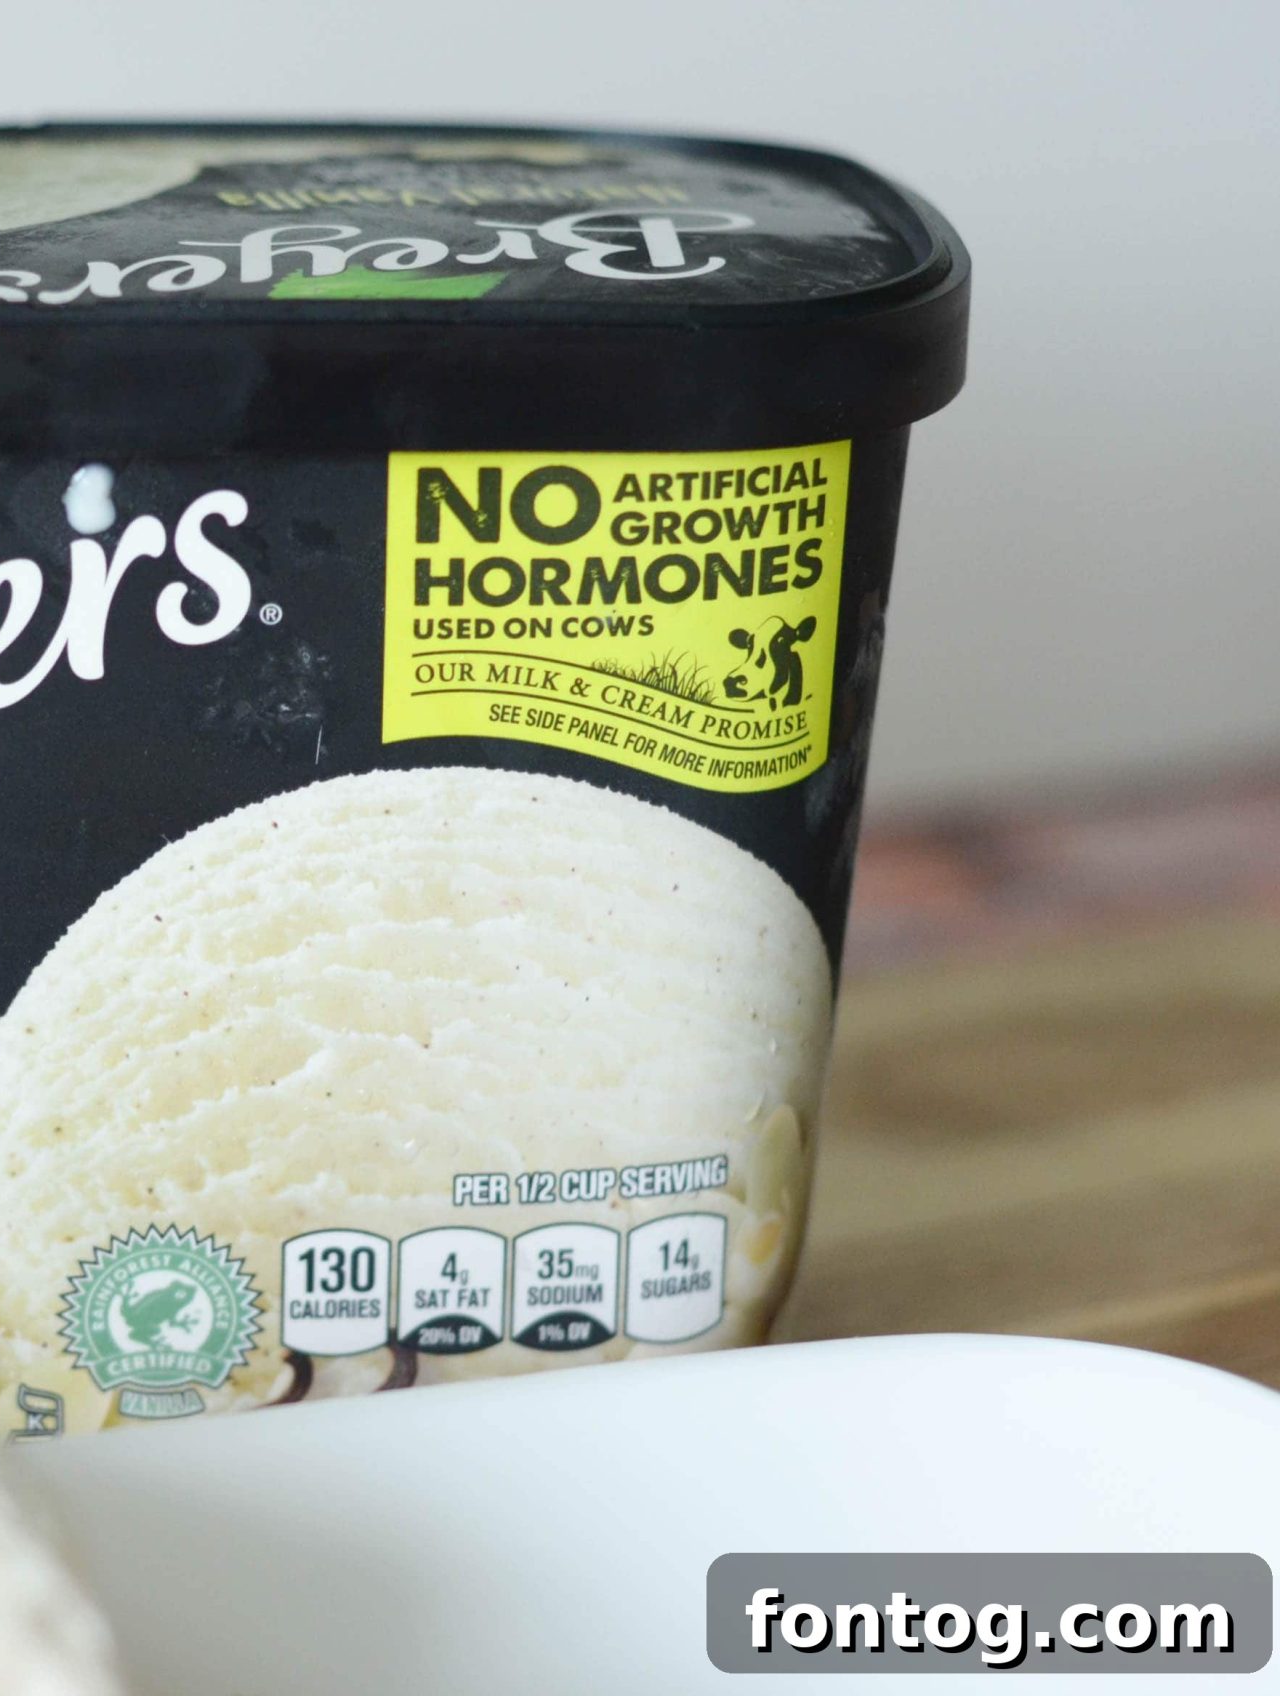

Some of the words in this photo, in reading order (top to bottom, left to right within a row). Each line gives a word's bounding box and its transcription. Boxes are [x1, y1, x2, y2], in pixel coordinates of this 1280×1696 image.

[612, 457, 828, 503] ARTIFICIAL
[416, 464, 602, 546] NO
[610, 494, 826, 546] GROWTH
[414, 537, 823, 608] HORMONES
[413, 617, 495, 640] USED
[503, 617, 552, 639] ON
[561, 615, 654, 638] COWS
[414, 662, 476, 684] OUR
[486, 662, 562, 692] MILK
[569, 676, 592, 698] &
[601, 684, 695, 729] CREAM
[699, 710, 808, 741] PROMISE
[488, 703, 523, 725] SEE
[525, 708, 566, 732] SIDE
[566, 716, 619, 747] PANEL
[623, 732, 658, 756] FOR
[658, 743, 708, 774] MORE
[453, 1173, 510, 1206] PER
[516, 1171, 557, 1205] 1/2
[560, 1167, 617, 1202] CUP
[619, 1155, 728, 1200] SERVING
[298, 1246, 376, 1293] 130
[440, 1251, 470, 1286] 4g
[537, 1248, 600, 1281] 35mg
[659, 1237, 700, 1272] 14g
[91, 1255, 172, 1331] RAINFOREST
[179, 1257, 231, 1330] ALLIANCE
[414, 1288, 450, 1310] SAT
[457, 1287, 491, 1309] FAT
[527, 1283, 603, 1307] SODIUM
[641, 1270, 712, 1300] SUGARS
[289, 1298, 381, 1320] CALORIES
[537, 1324, 565, 1343] 1%
[568, 1321, 592, 1341] DV
[106, 1351, 213, 1377] CERTIFIED
